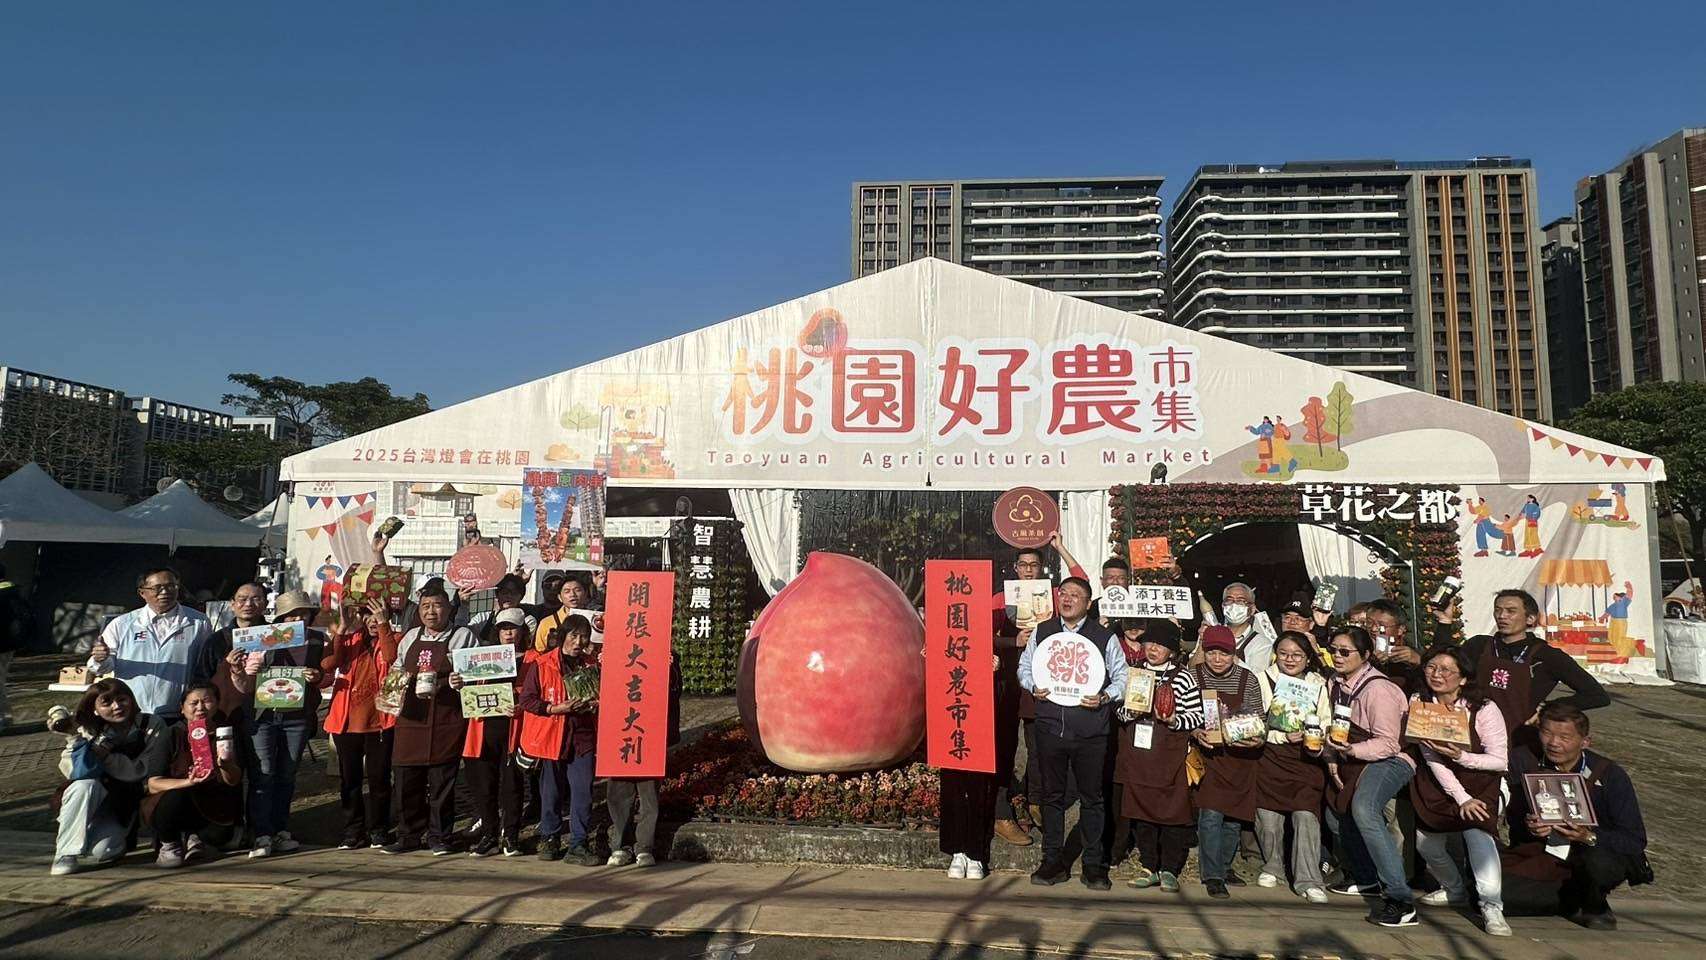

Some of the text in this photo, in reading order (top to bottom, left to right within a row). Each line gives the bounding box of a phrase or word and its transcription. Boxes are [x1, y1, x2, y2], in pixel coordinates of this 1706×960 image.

[722, 343, 1142, 435] 桃園好農
[1150, 346, 1197, 434] 市集
[353, 448, 531, 466] 2025台灣燈會在桃園
[708, 448, 1213, 468] Taoyuan Agricultural Market
[1297, 484, 1459, 525] 草花之都
[688, 524, 714, 640] 智慧農耕
[1135, 587, 1189, 602] 添丁養生
[1136, 603, 1178, 617] 黑木耳
[618, 582, 651, 766] 開張大吉大利
[944, 570, 973, 761] 桃園好農市集
